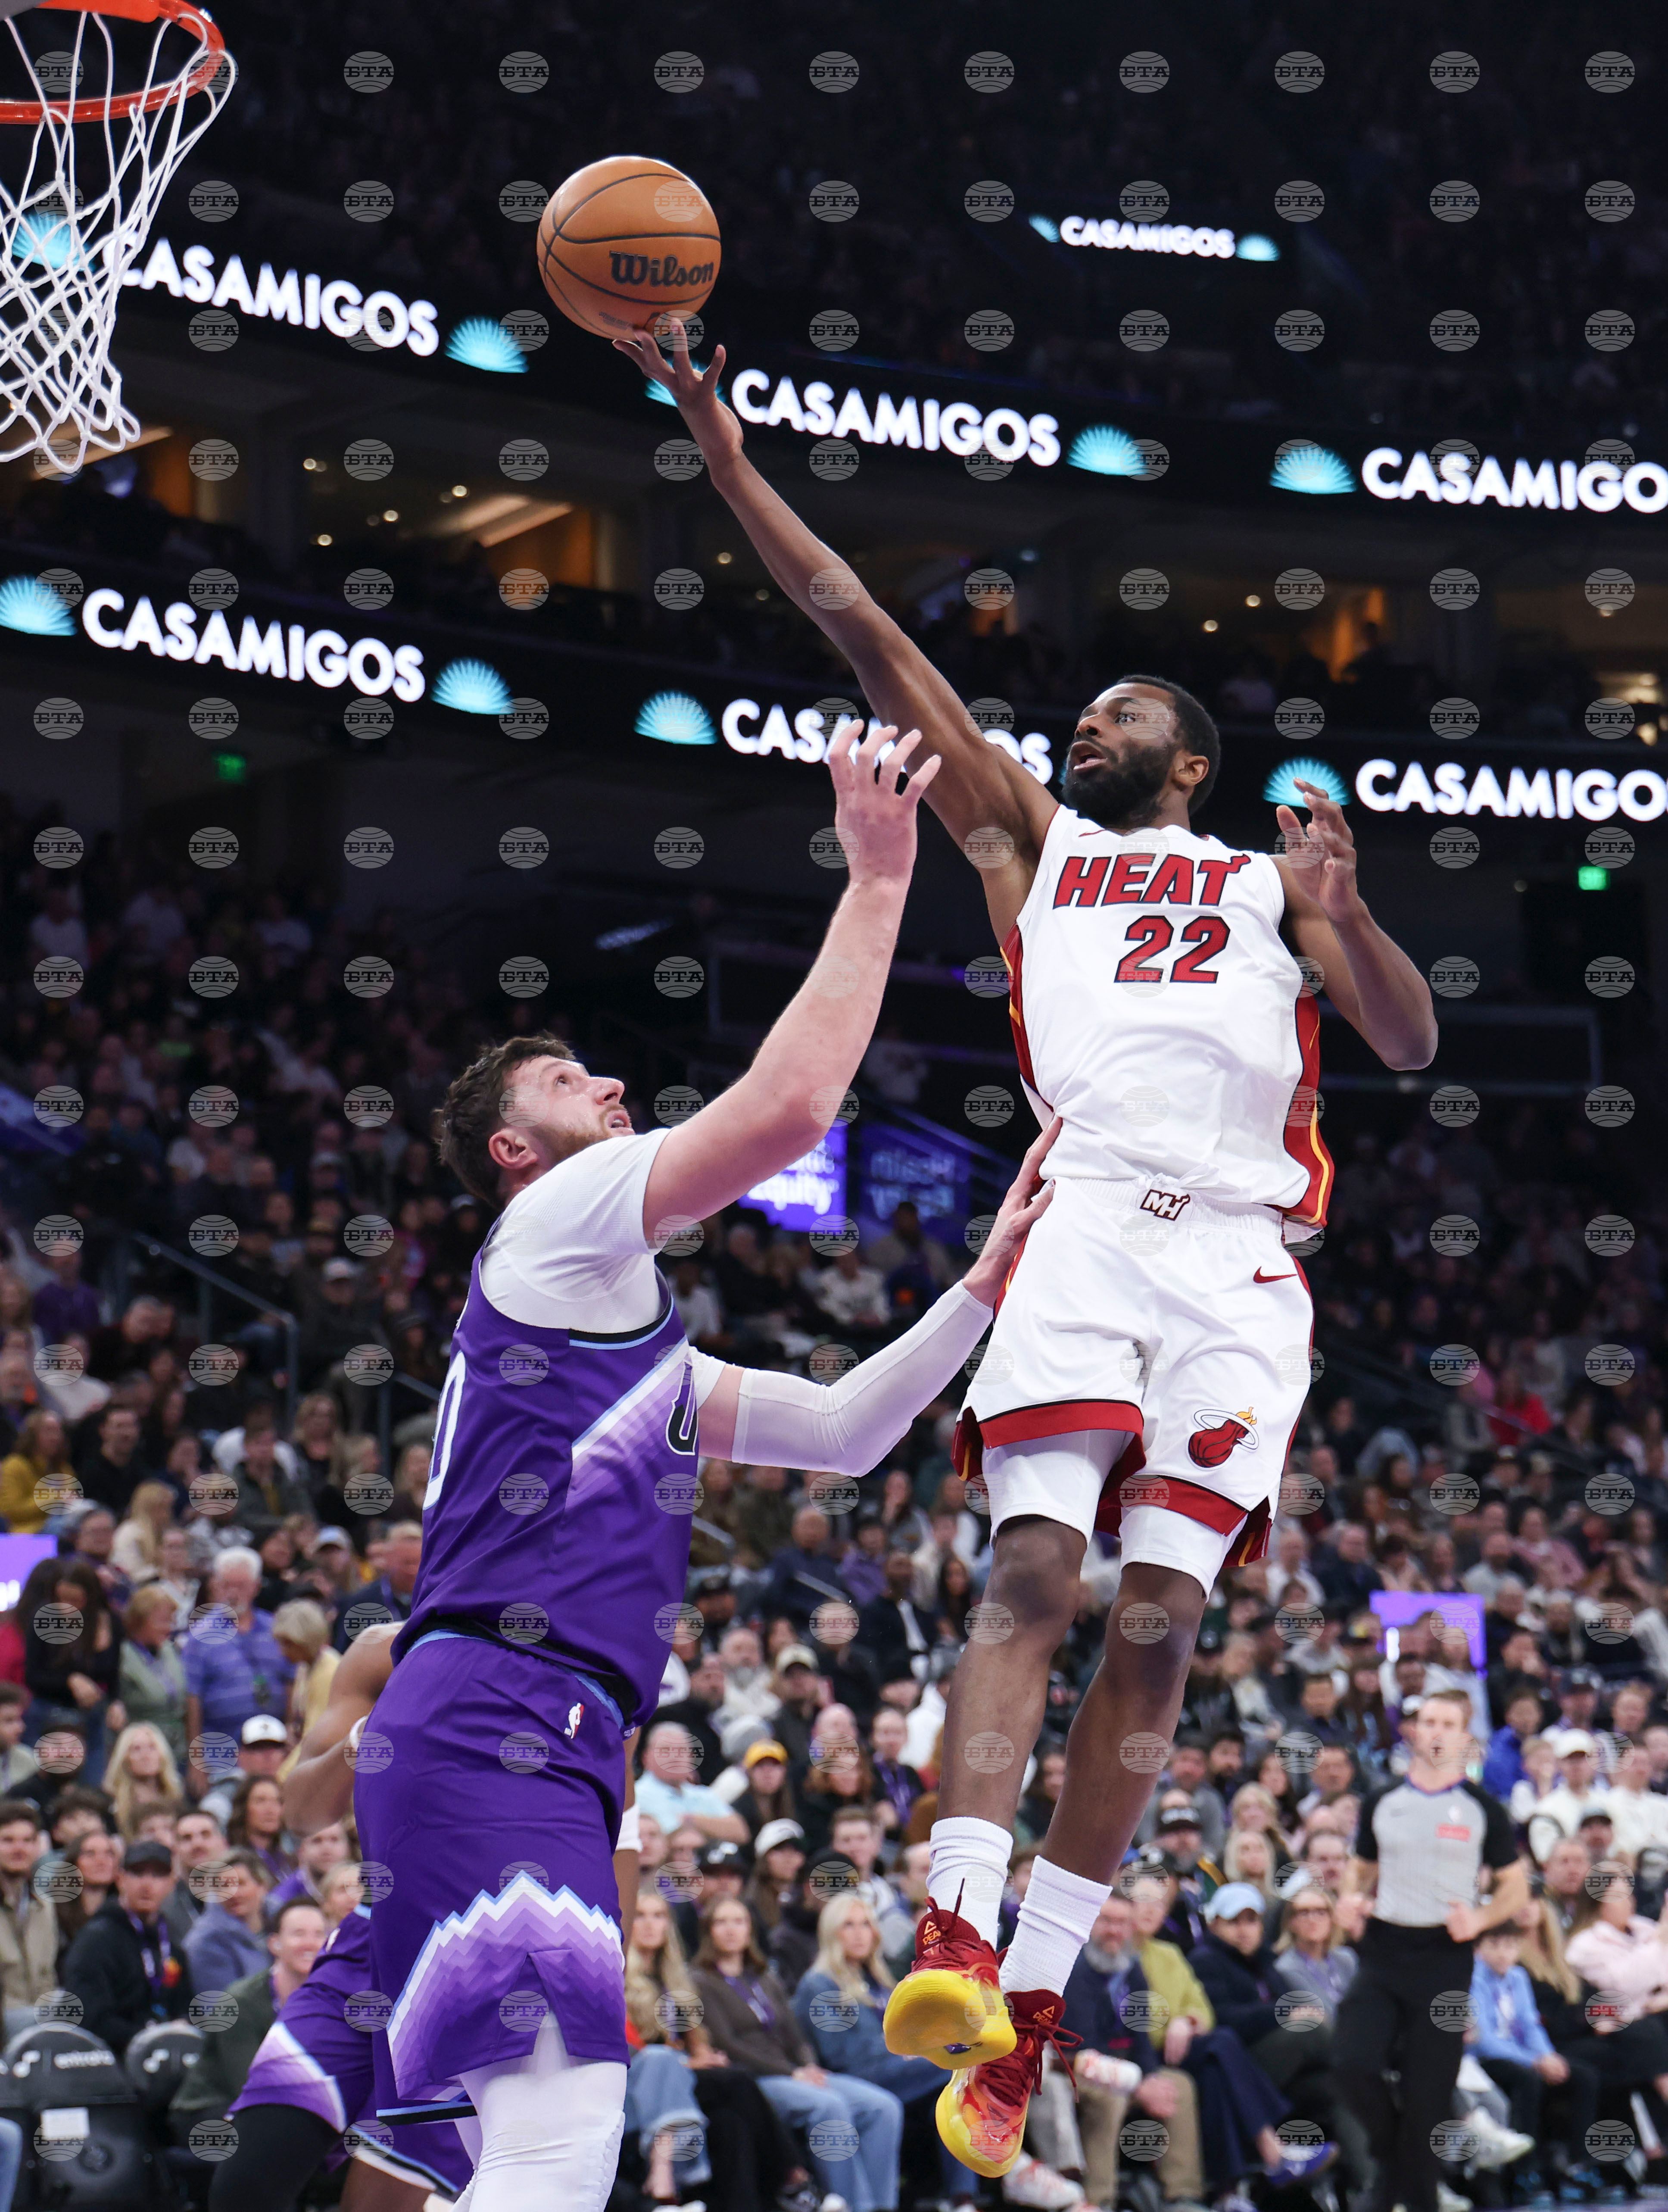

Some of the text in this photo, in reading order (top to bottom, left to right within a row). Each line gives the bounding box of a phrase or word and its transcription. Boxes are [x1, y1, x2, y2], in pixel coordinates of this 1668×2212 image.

[609, 249, 714, 287] Wilson
[1060, 215, 1235, 259] CASAMIGOS
[731, 368, 1059, 467] CASAMIGOS
[82, 589, 425, 702] CASAMIGOS
[1356, 759, 1668, 822] CASAMIGO
[1053, 853, 1251, 910] HEAT
[1114, 915, 1231, 984] 22
